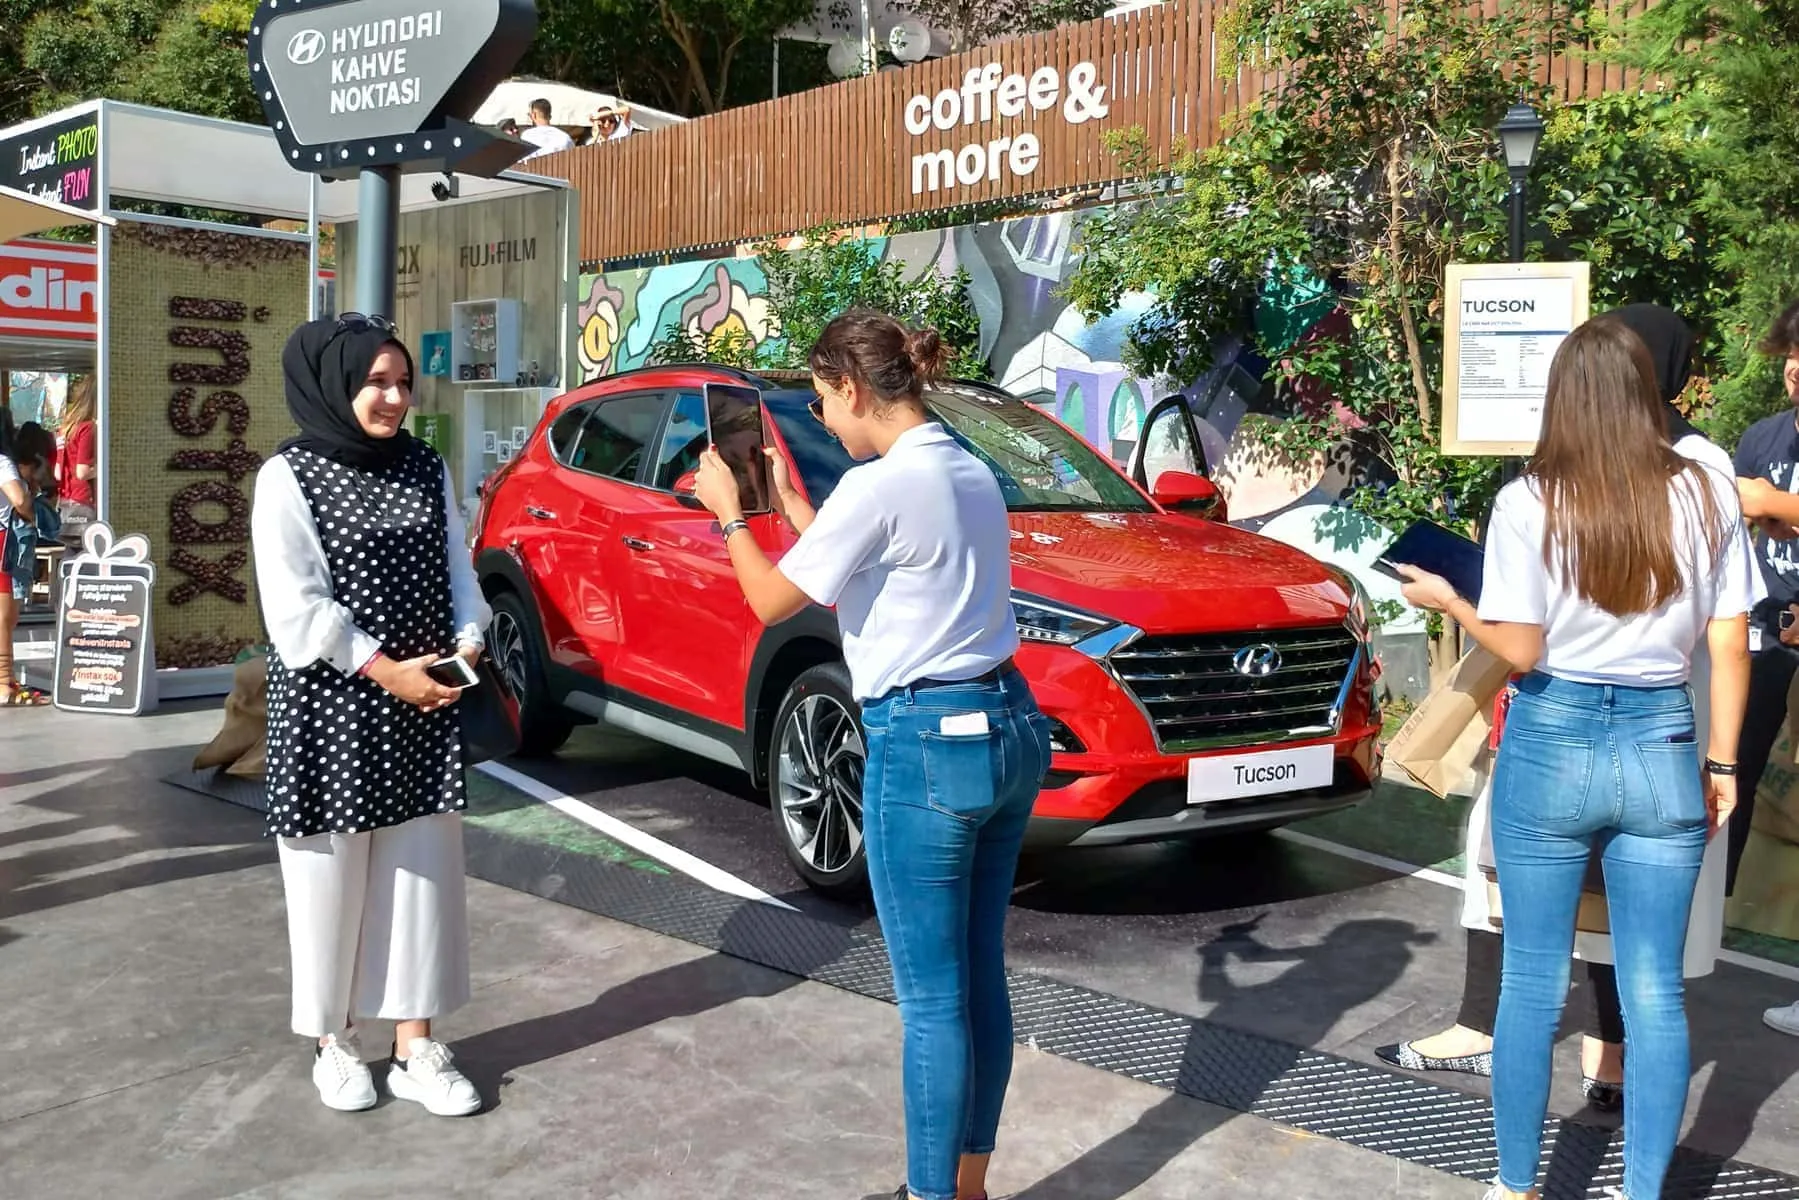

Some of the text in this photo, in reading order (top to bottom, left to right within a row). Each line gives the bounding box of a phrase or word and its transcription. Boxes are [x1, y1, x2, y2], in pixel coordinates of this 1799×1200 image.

[331, 10, 442, 54] HYUNDAI
[331, 48, 407, 84] KAHVE
[330, 77, 421, 114] NOKTASI
[904, 61, 1109, 135] coffee &
[19, 124, 98, 175] Instant PHOTO
[911, 132, 1040, 195] more
[63, 167, 91, 203] FUN
[1462, 299, 1536, 313] TUCSON
[168, 295, 271, 606] instax
[1233, 763, 1296, 785] Tucson
